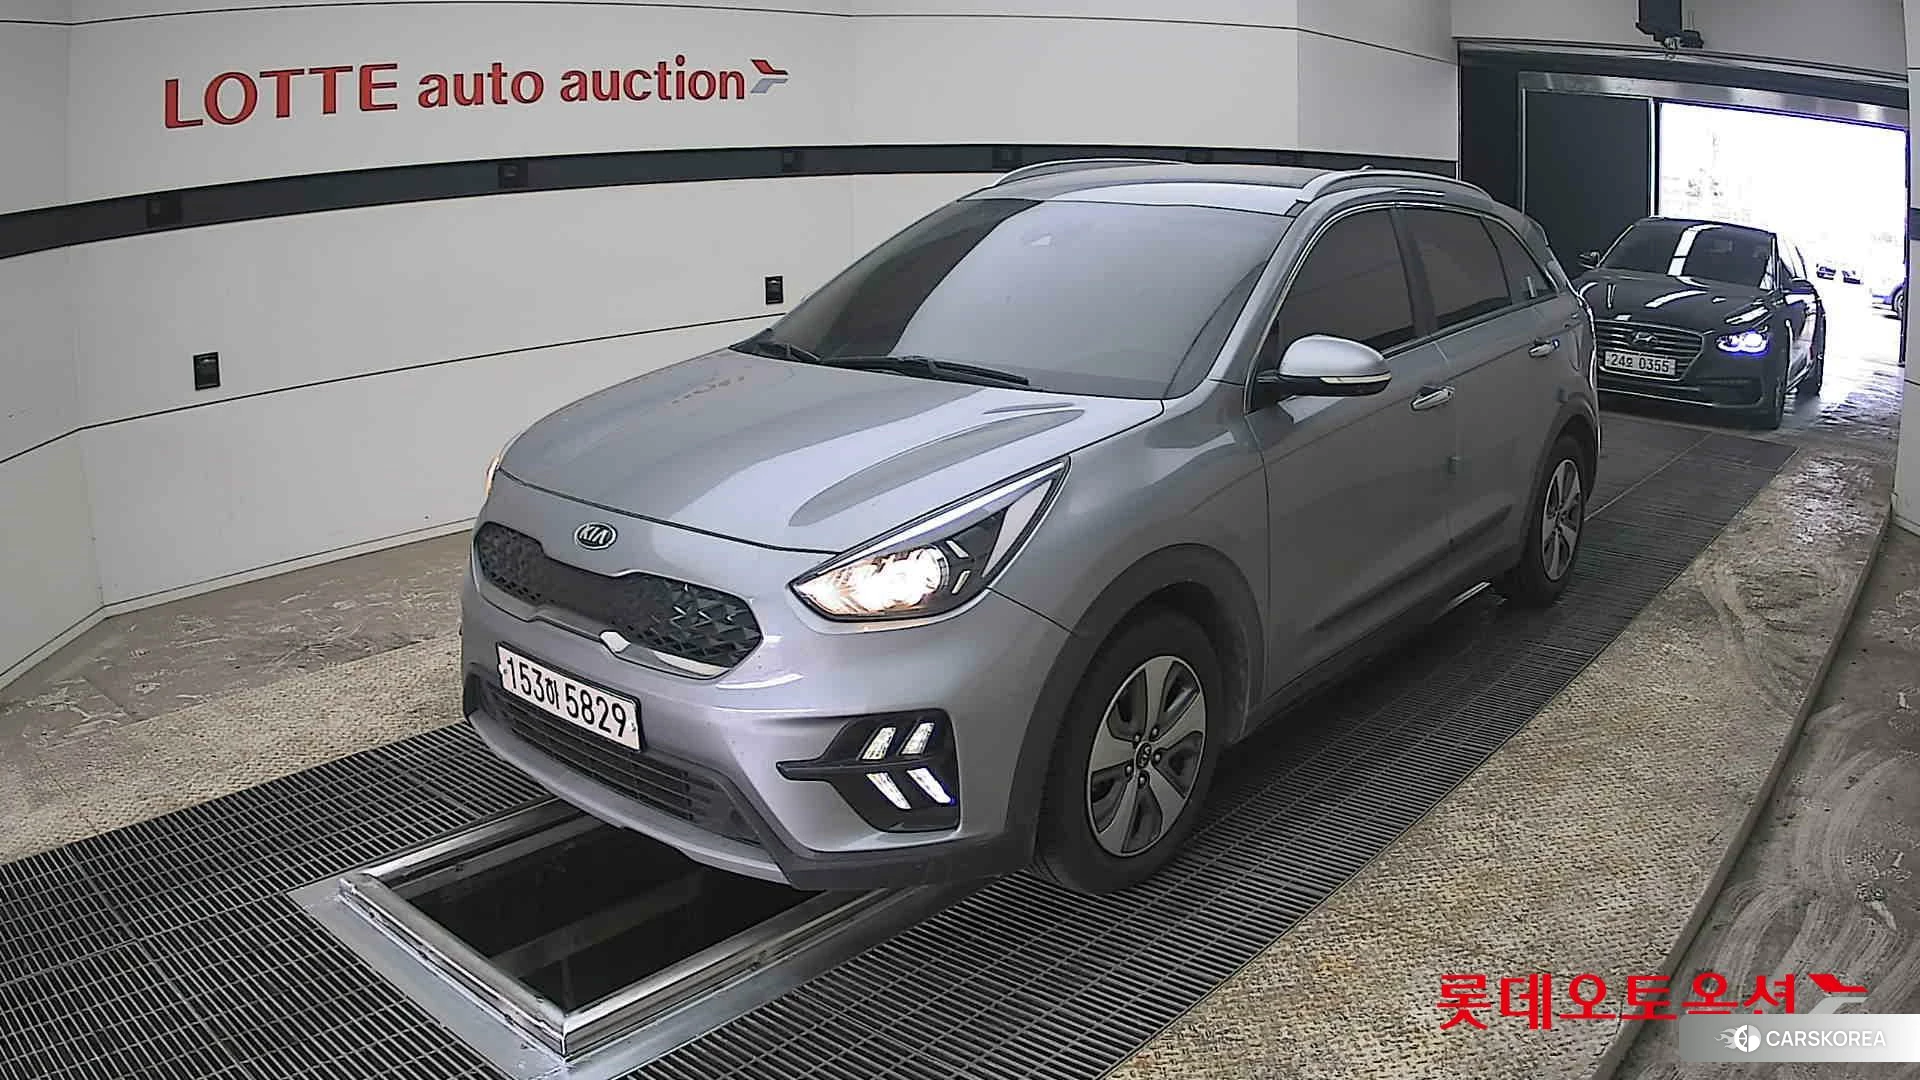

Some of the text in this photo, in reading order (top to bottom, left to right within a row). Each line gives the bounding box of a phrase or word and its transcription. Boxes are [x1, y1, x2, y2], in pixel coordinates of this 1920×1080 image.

[165, 54, 745, 129] LOTTE auto auction
[579, 525, 608, 545] KIA
[565, 682, 626, 738] 5829
